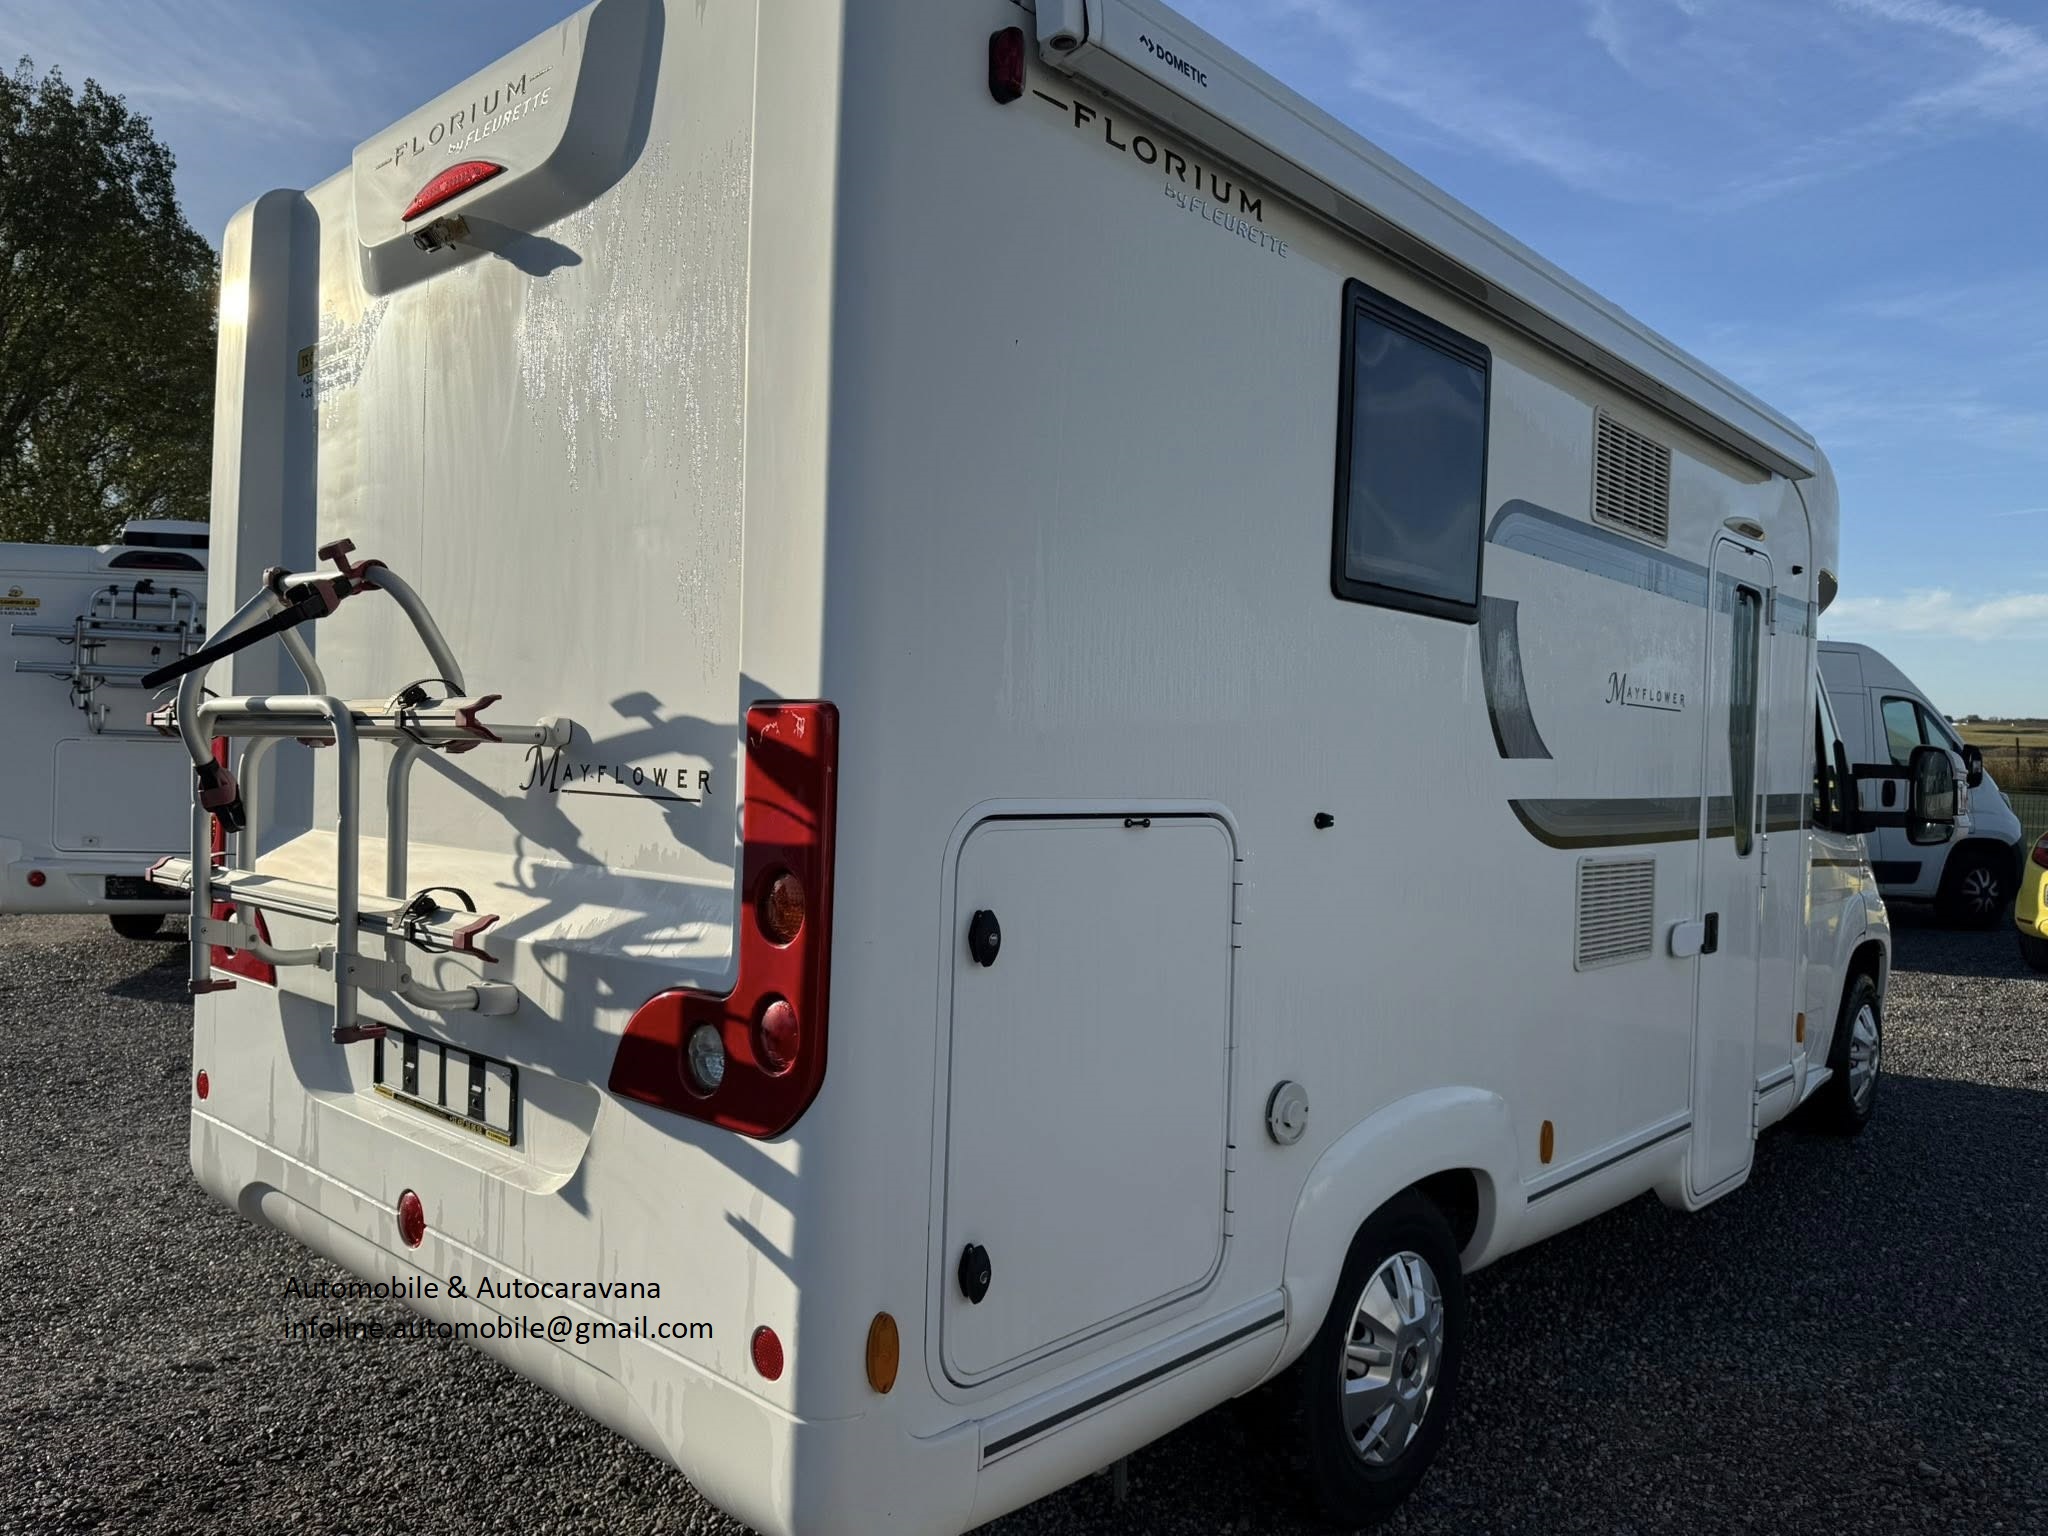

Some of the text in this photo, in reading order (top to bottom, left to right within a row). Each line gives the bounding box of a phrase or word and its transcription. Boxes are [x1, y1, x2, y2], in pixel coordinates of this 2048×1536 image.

[1155, 43, 1208, 88] DOMETIC
[394, 74, 527, 167] FLORIUM
[446, 86, 552, 156] by FLEURETTE
[1072, 99, 1264, 223] FLORIUM
[1164, 182, 1289, 258] by FLEURETTE
